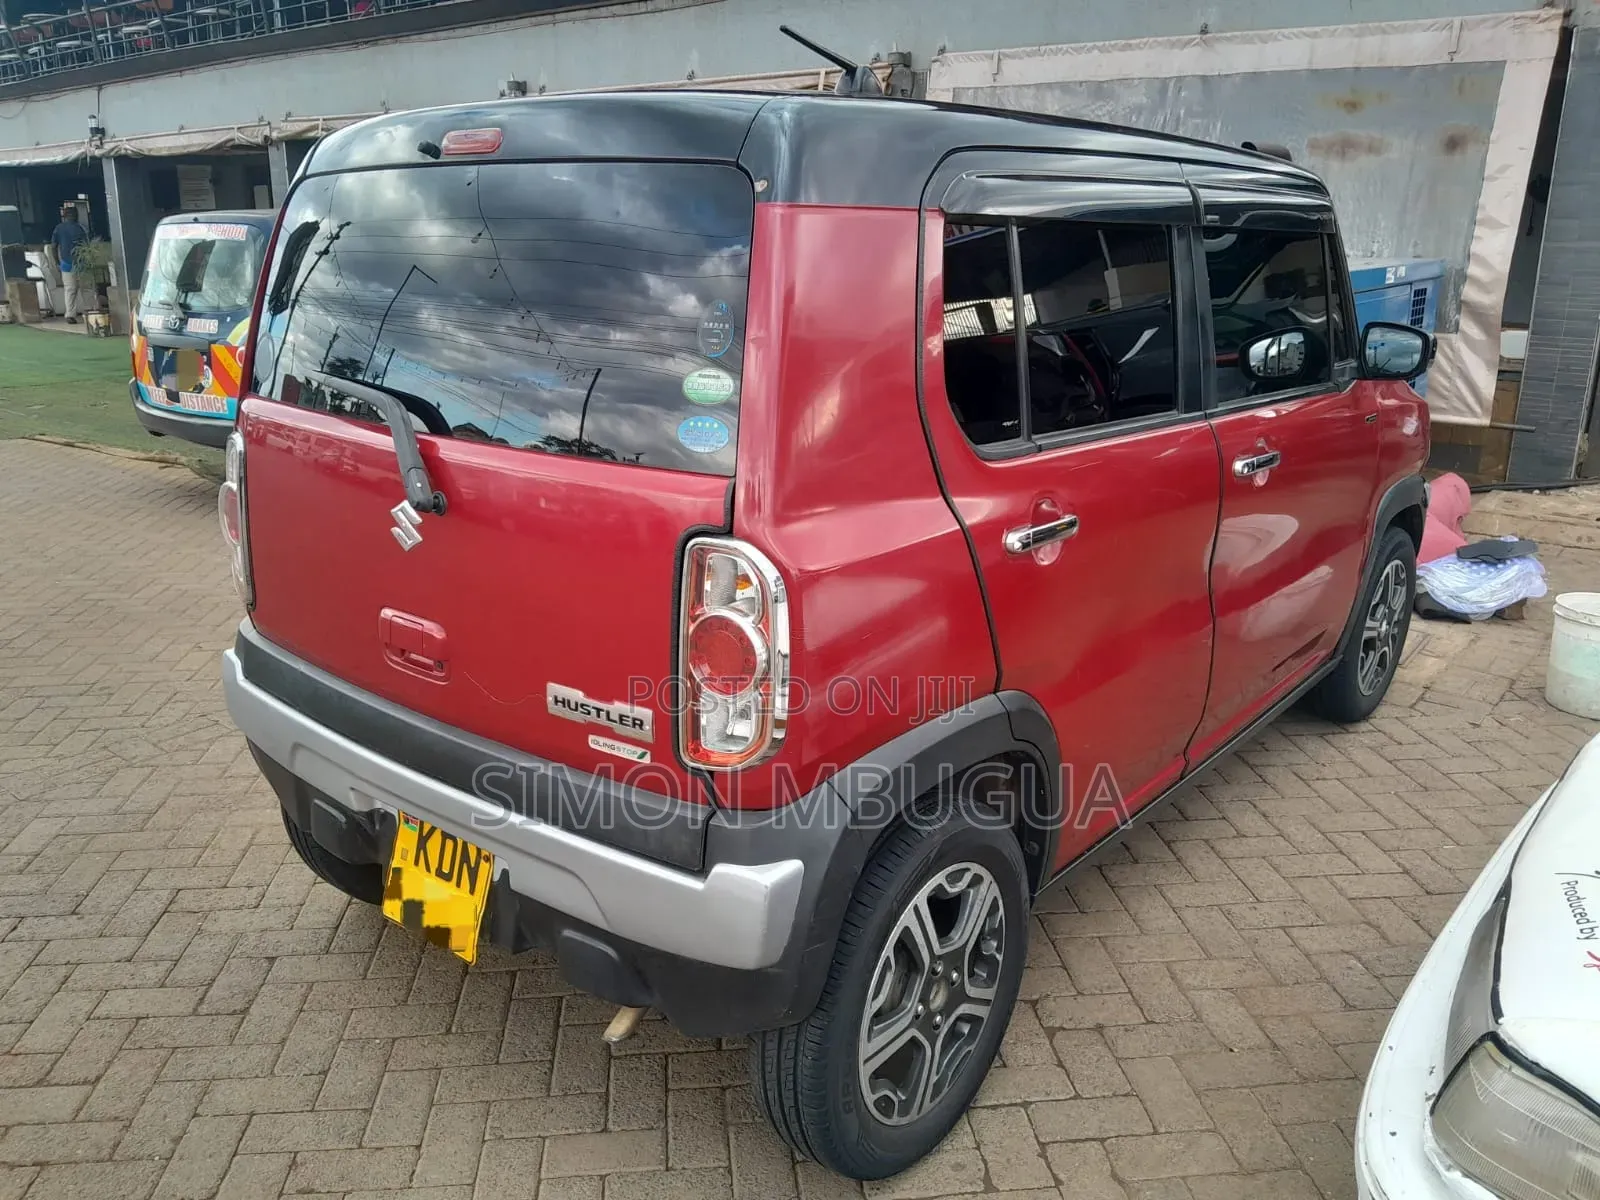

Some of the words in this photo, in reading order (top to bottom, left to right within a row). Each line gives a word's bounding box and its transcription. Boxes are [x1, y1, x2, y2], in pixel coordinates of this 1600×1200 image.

[181, 393, 227, 412] DISTANCE
[553, 695, 645, 731] HUSTLER
[414, 820, 482, 896] KDN
[1560, 879, 1597, 925] Produced
[1576, 926, 1600, 941] by
